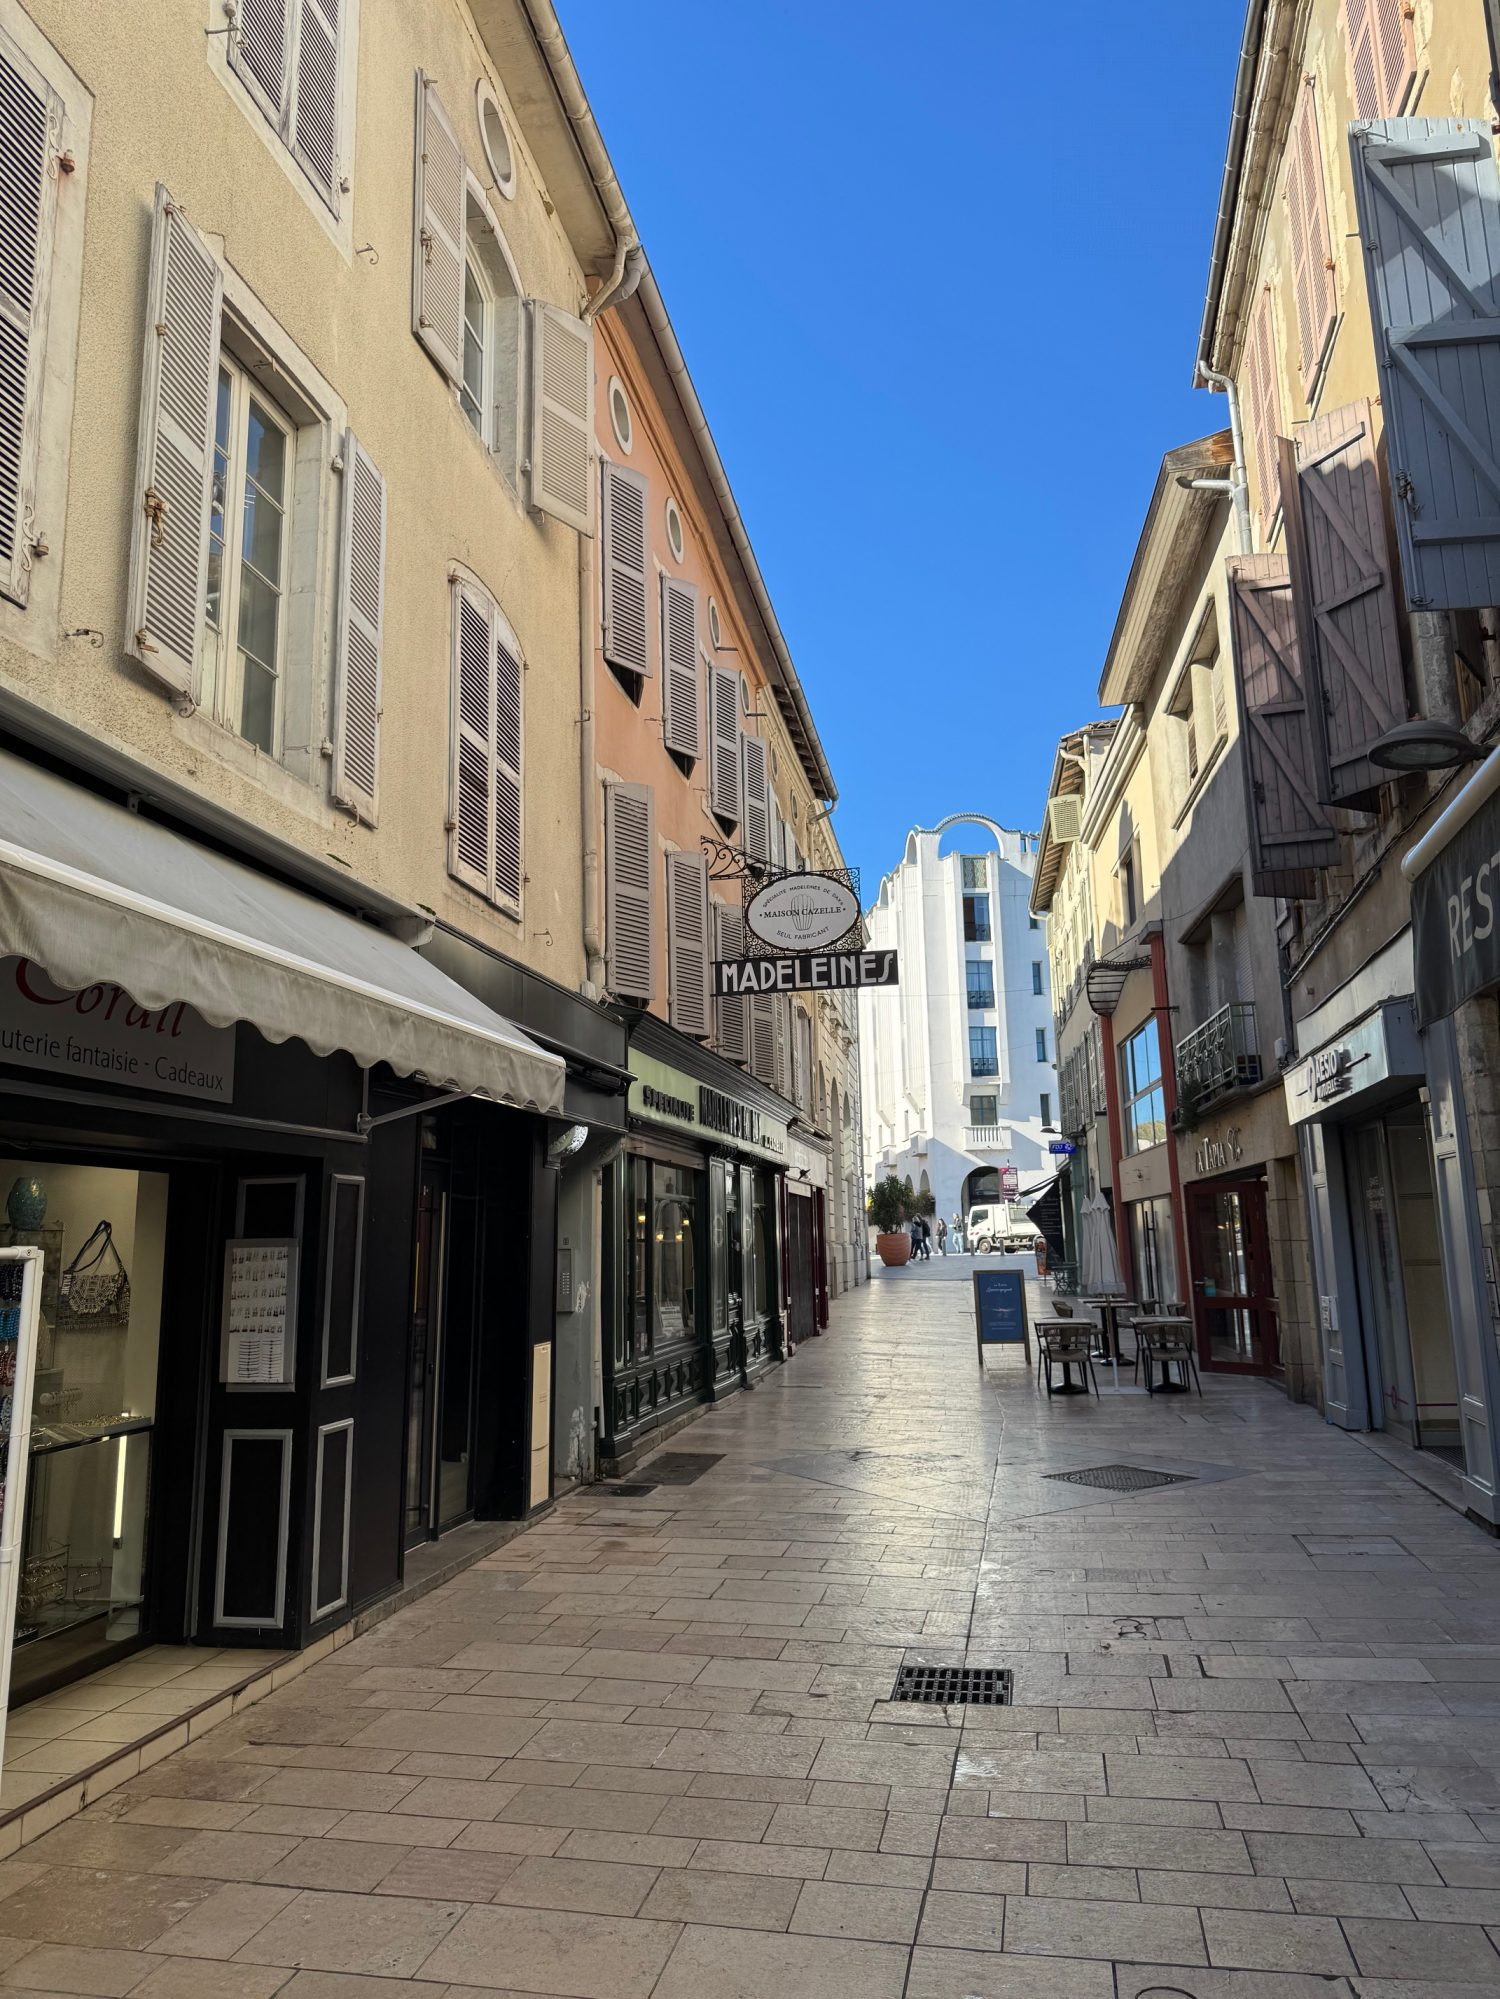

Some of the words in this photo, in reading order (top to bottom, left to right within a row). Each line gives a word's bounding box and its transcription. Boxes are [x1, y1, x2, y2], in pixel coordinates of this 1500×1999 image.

[764, 910, 799, 918] MAISON
[802, 907, 841, 915] CAZELLE
[776, 930, 791, 939] SEUL
[794, 926, 830, 940] FABRICANT
[722, 952, 893, 993] MADELEINES
[66, 1036, 138, 1073] fantaisie
[155, 1056, 223, 1091] Cadeaux
